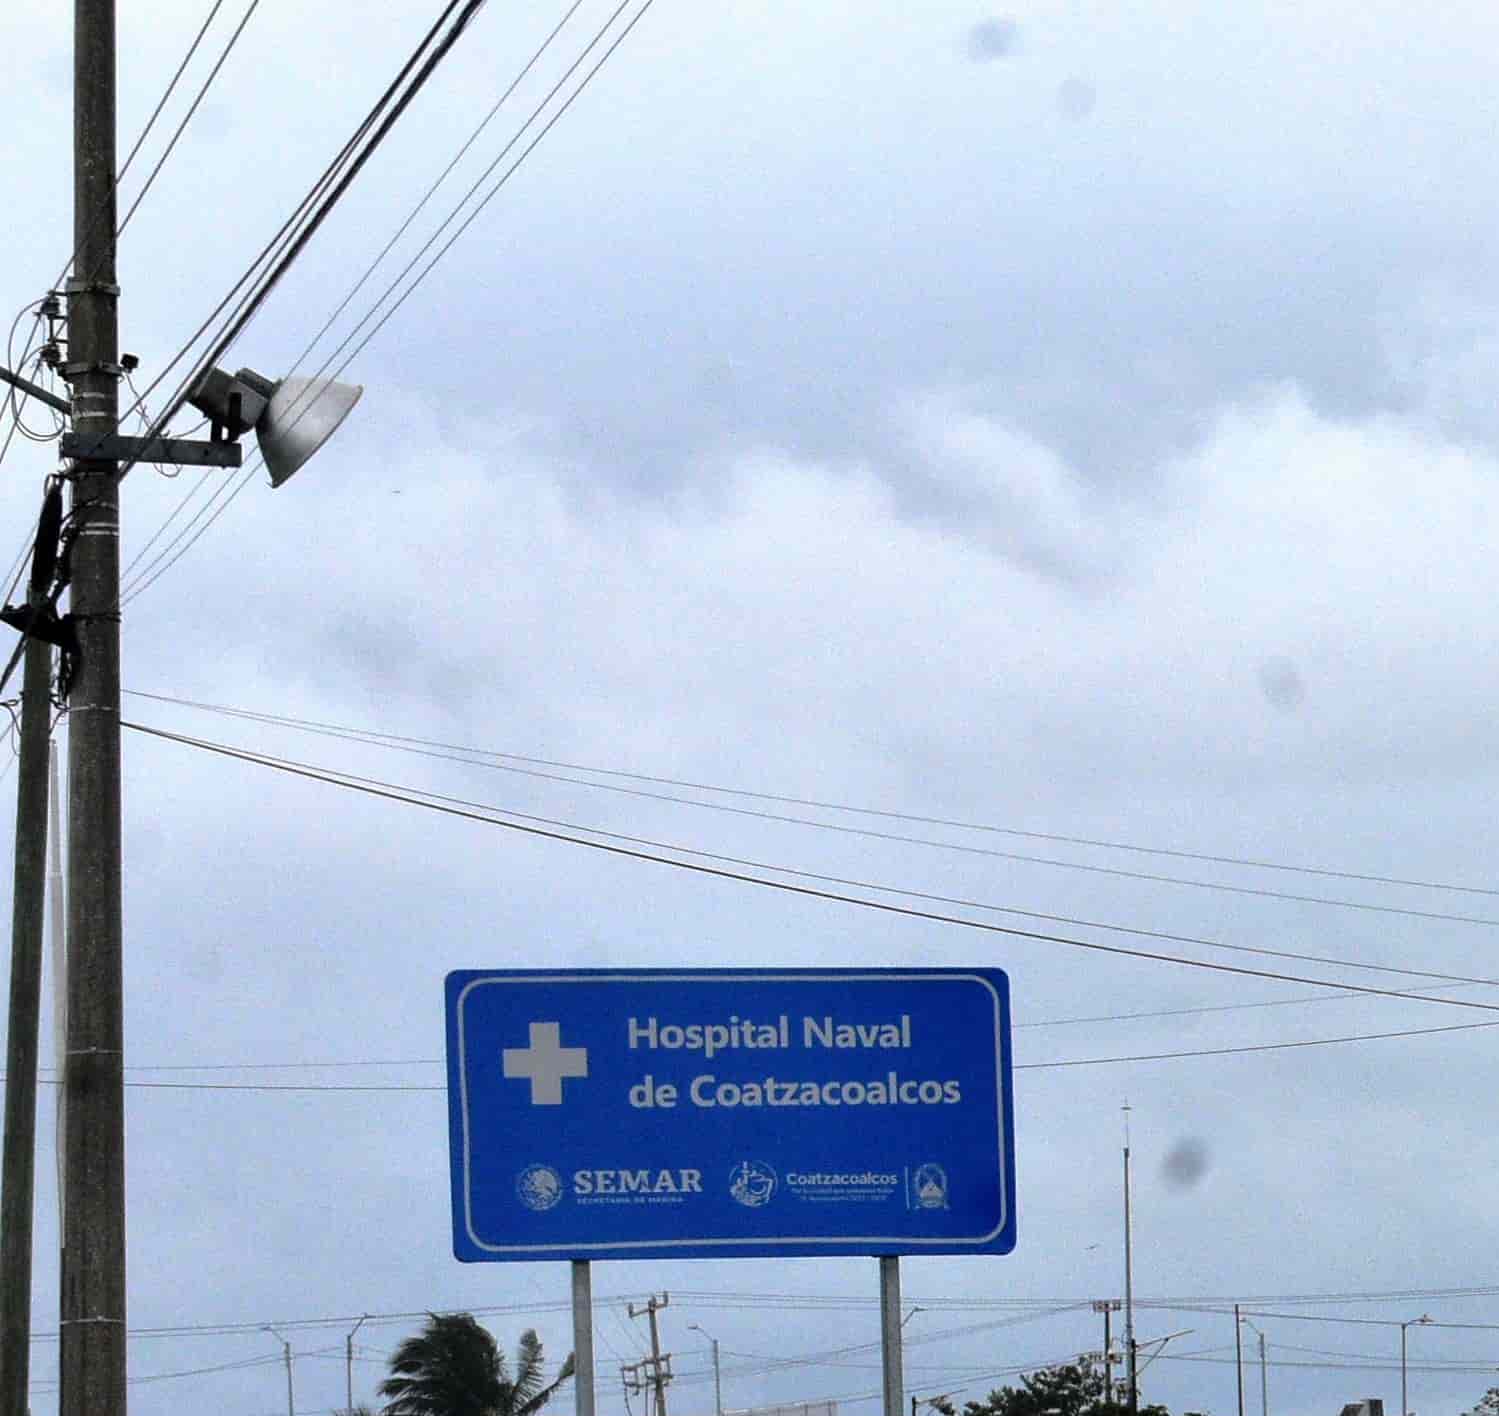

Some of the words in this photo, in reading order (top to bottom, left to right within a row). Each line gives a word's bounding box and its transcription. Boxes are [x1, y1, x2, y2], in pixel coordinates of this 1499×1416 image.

[628, 1016, 790, 1058] Hospital
[803, 1016, 911, 1049] Naval
[629, 1077, 677, 1109] de
[690, 1073, 961, 1107] Coatzacoalcos
[574, 1169, 703, 1194] SEMAR
[786, 1171, 898, 1186] Coatzacoalcos
